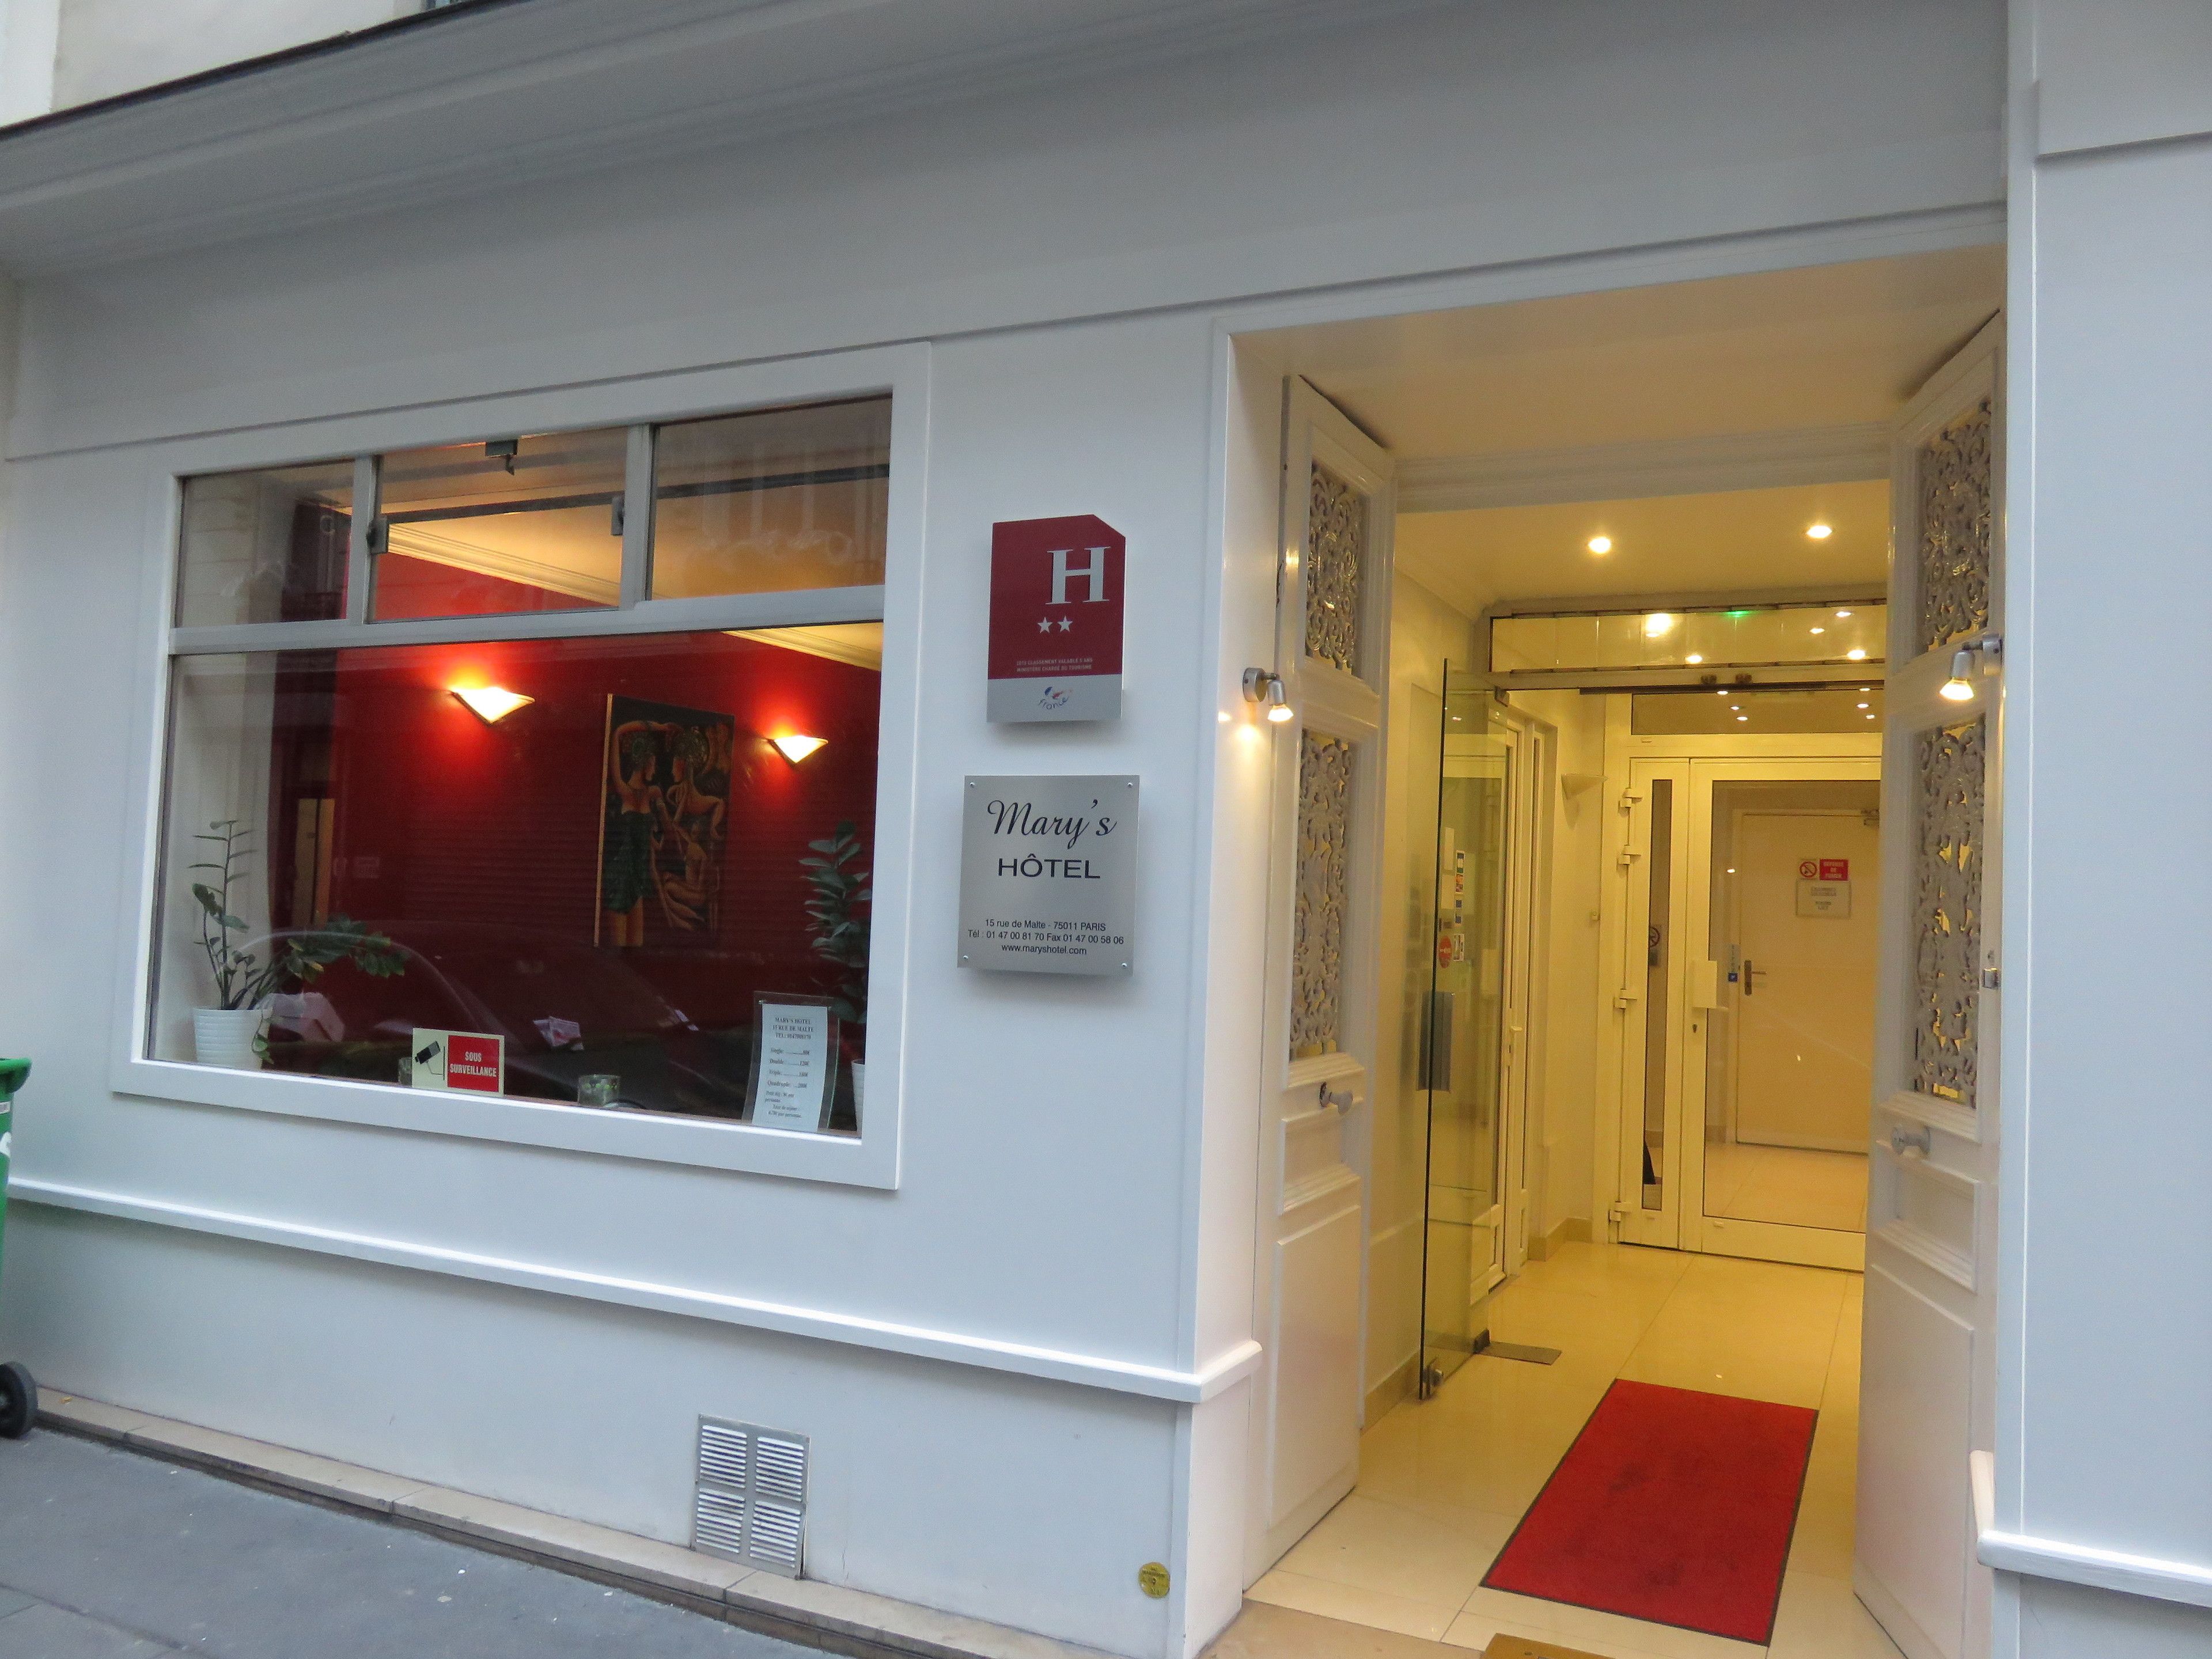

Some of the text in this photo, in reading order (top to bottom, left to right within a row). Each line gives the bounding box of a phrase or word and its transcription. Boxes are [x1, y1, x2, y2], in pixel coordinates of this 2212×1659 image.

[1046, 546, 1111, 604] H
[987, 798, 1118, 850] Mary's
[998, 853, 1101, 879] HÔTEL
[986, 919, 995, 927] 15
[1012, 920, 1022, 928] de
[1024, 920, 1046, 929] Malte
[1054, 922, 1077, 930] 75011
[1081, 922, 1106, 931] PARIS
[1010, 932, 1020, 940] 00
[1047, 933, 1060, 942] Fax
[1063, 934, 1072, 942] 01
[1075, 934, 1086, 942] 47
[1088, 935, 1099, 943] 00
[1101, 935, 1111, 944] 58
[1113, 936, 1124, 945] 06
[1001, 945, 1087, 955] www.maryshotel.com
[465, 1051, 482, 1062] SOUS
[449, 1063, 497, 1078] SURVEILLANCE
